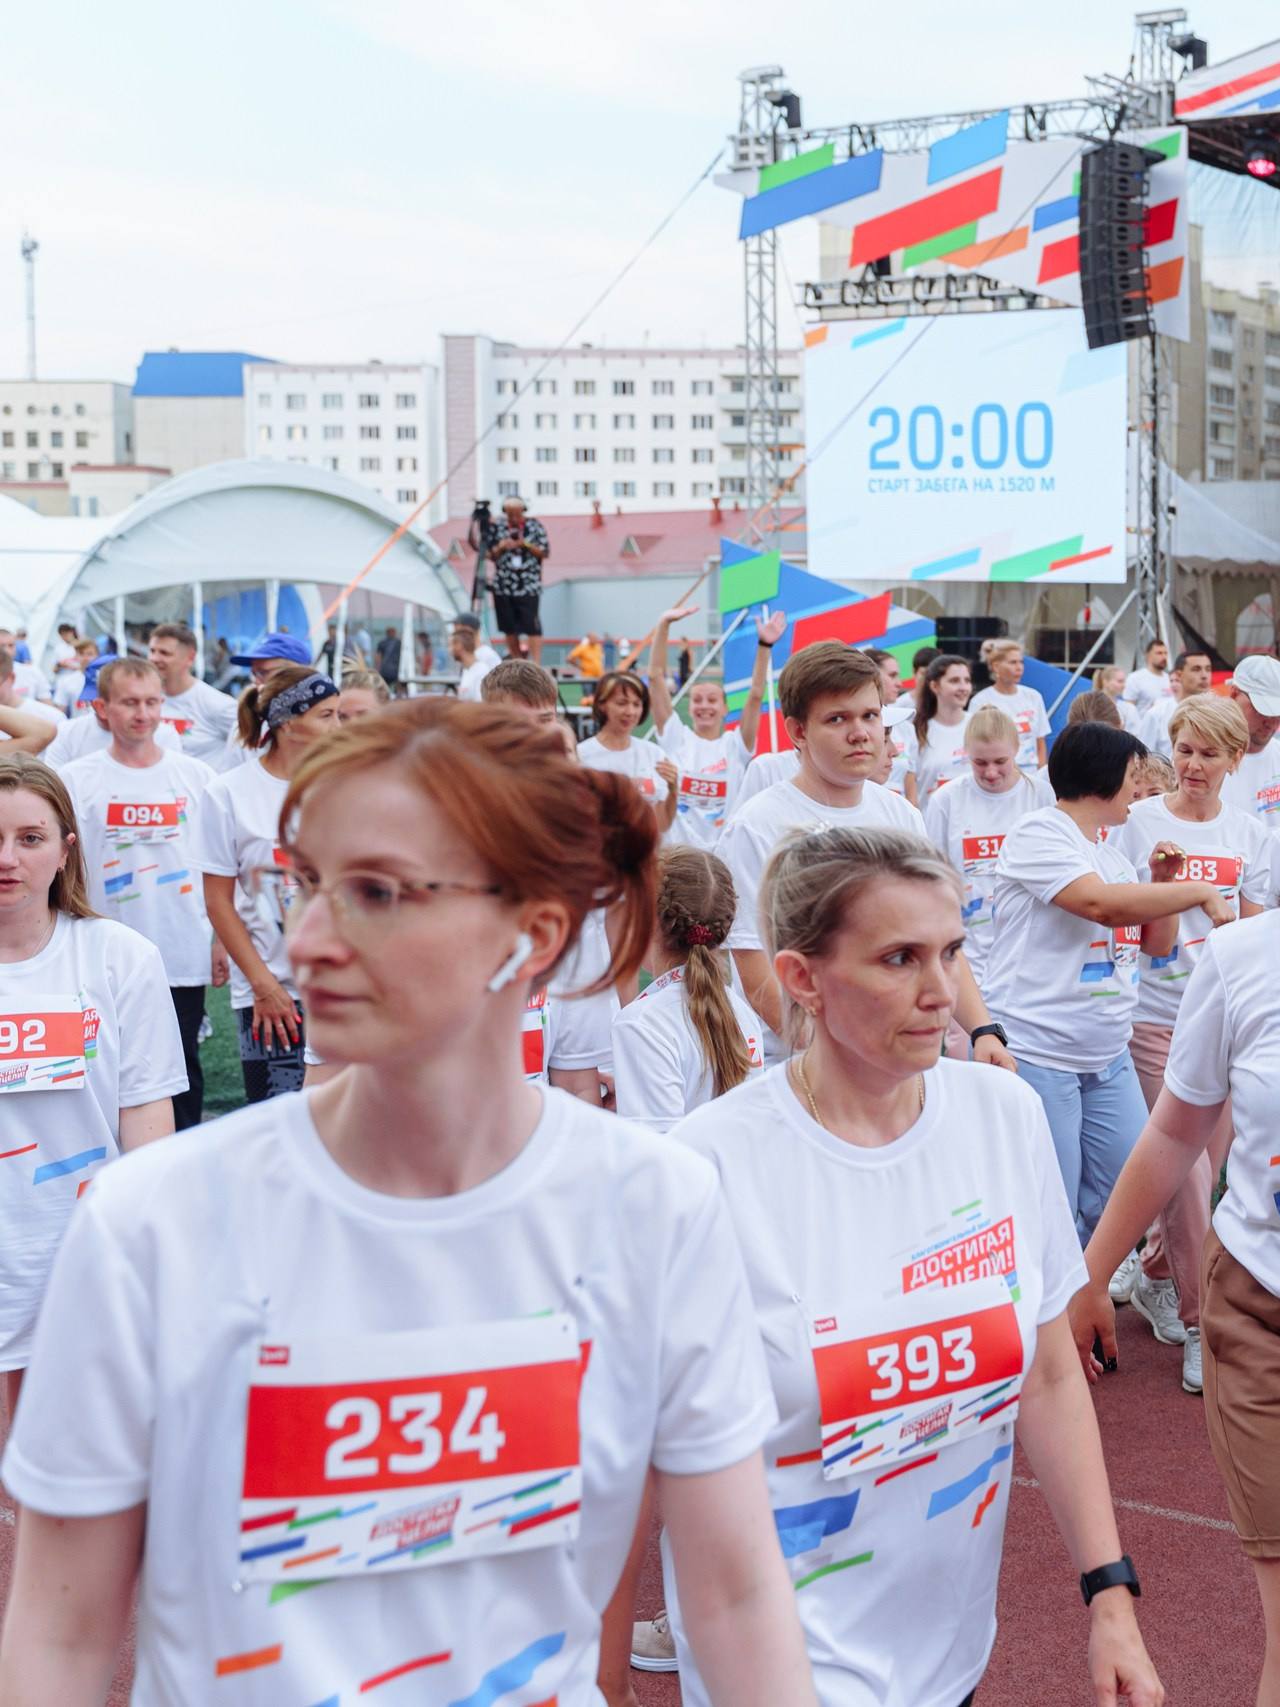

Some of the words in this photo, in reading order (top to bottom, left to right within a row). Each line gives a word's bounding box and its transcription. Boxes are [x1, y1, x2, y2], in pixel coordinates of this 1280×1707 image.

[868, 401, 1054, 471] 20:00
[867, 477, 911, 494] СТАРТ
[915, 477, 969, 493] ЗАБЕГА
[972, 477, 994, 493] НА
[999, 476, 1036, 492] 1520
[1040, 476, 1055, 492] М
[689, 780, 719, 796] 223
[121, 806, 165, 825] 094
[977, 838, 1000, 857] 31
[0, 1019, 46, 1054] 92
[909, 1221, 1012, 1289] ДОСТИГАЯ
[866, 1325, 977, 1402] 393
[323, 1386, 507, 1481] 234
